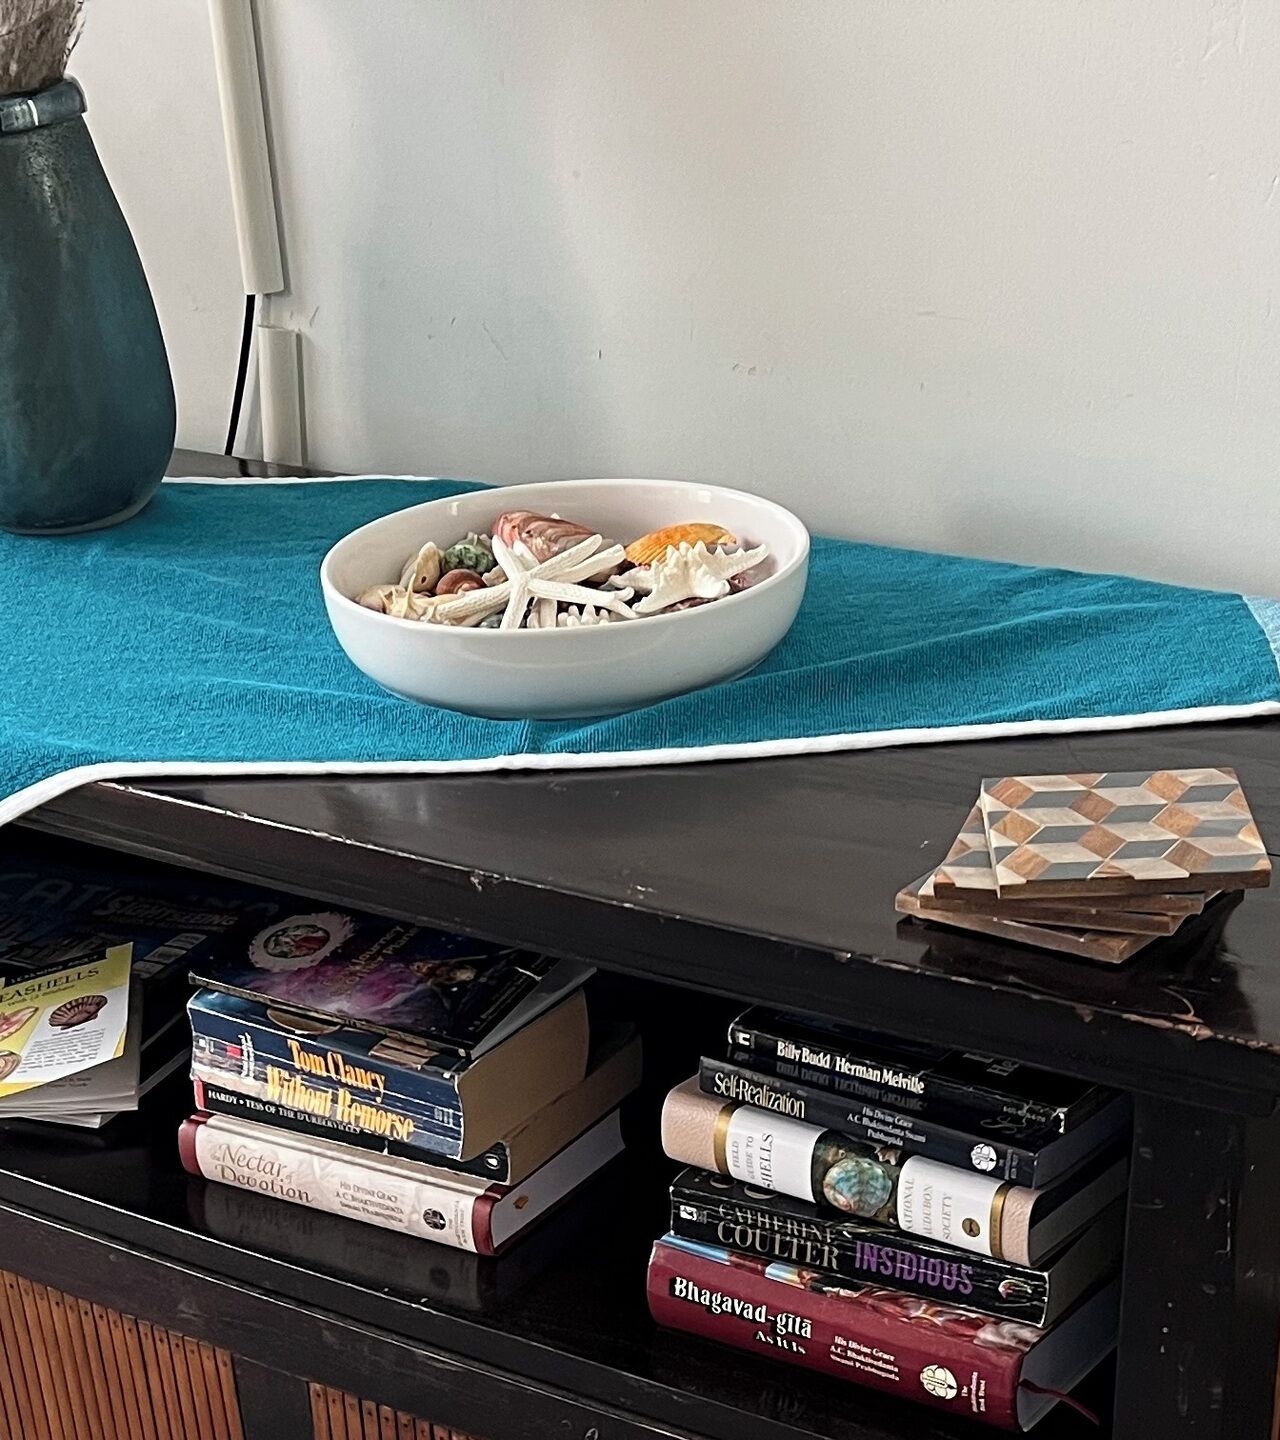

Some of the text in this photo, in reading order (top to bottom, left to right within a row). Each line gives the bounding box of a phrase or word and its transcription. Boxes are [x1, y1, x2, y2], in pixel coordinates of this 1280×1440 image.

[287, 1039, 327, 1077] Tom
[327, 1051, 386, 1104] Clancy
[777, 1041, 801, 1062] Billy
[801, 1048, 830, 1069] Budd
[835, 1057, 881, 1083] Herman
[881, 1068, 925, 1094] Melville
[208, 1089, 237, 1105] HARDY
[245, 1098, 265, 1112] TESS
[265, 1103, 276, 1114] OF
[279, 1106, 296, 1119] THE
[266, 1064, 417, 1142] Without Remorse
[714, 1072, 805, 1119] Self-Realization
[219, 1143, 287, 1178] Nectar
[732, 1141, 740, 1168] FIELD
[746, 1136, 754, 1148] TO
[760, 1133, 776, 1189] SHELLS
[214, 1163, 313, 1203] Devotion
[719, 1203, 838, 1243] CATHERINE
[941, 1193, 953, 1240] SOCIETY
[718, 1220, 840, 1270] COULTER
[854, 1241, 974, 1295] INSIDIOUS
